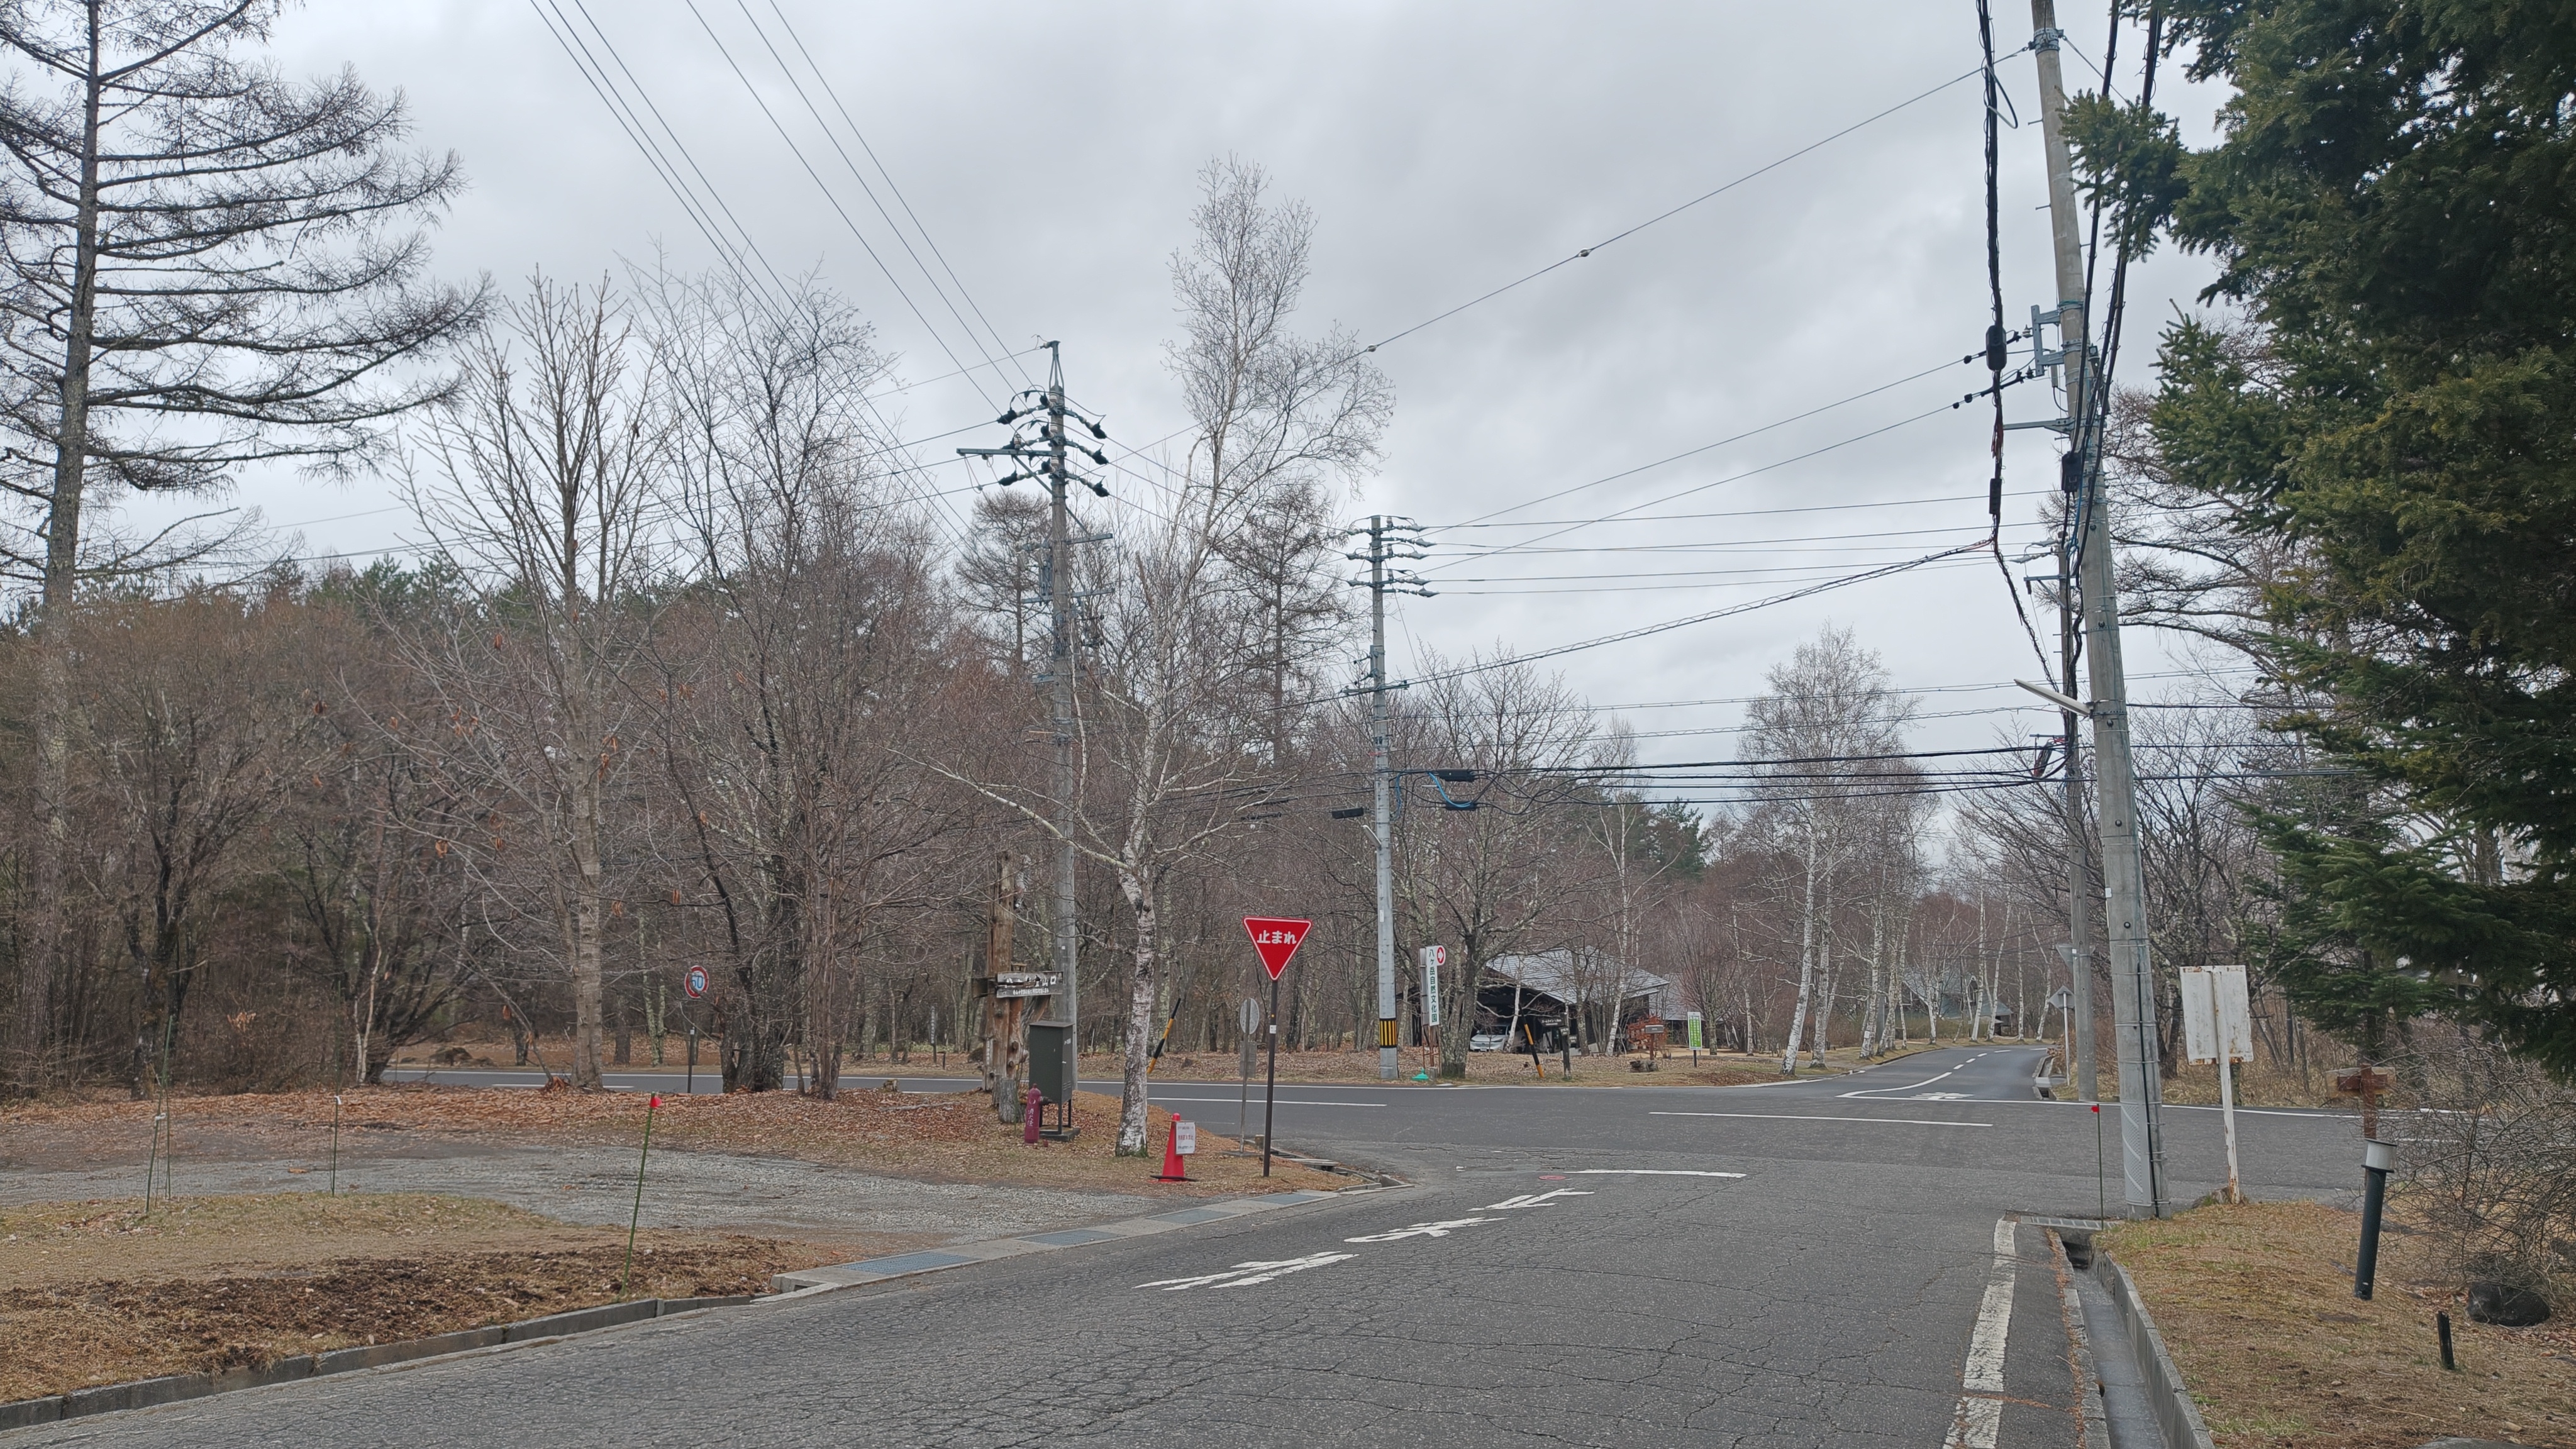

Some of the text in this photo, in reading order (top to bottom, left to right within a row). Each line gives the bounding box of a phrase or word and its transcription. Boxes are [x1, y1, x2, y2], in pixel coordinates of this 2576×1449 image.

[1257, 930, 1297, 945] 止まれ
[691, 975, 704, 989] 50
[1134, 1187, 1595, 1291] 止まれ
